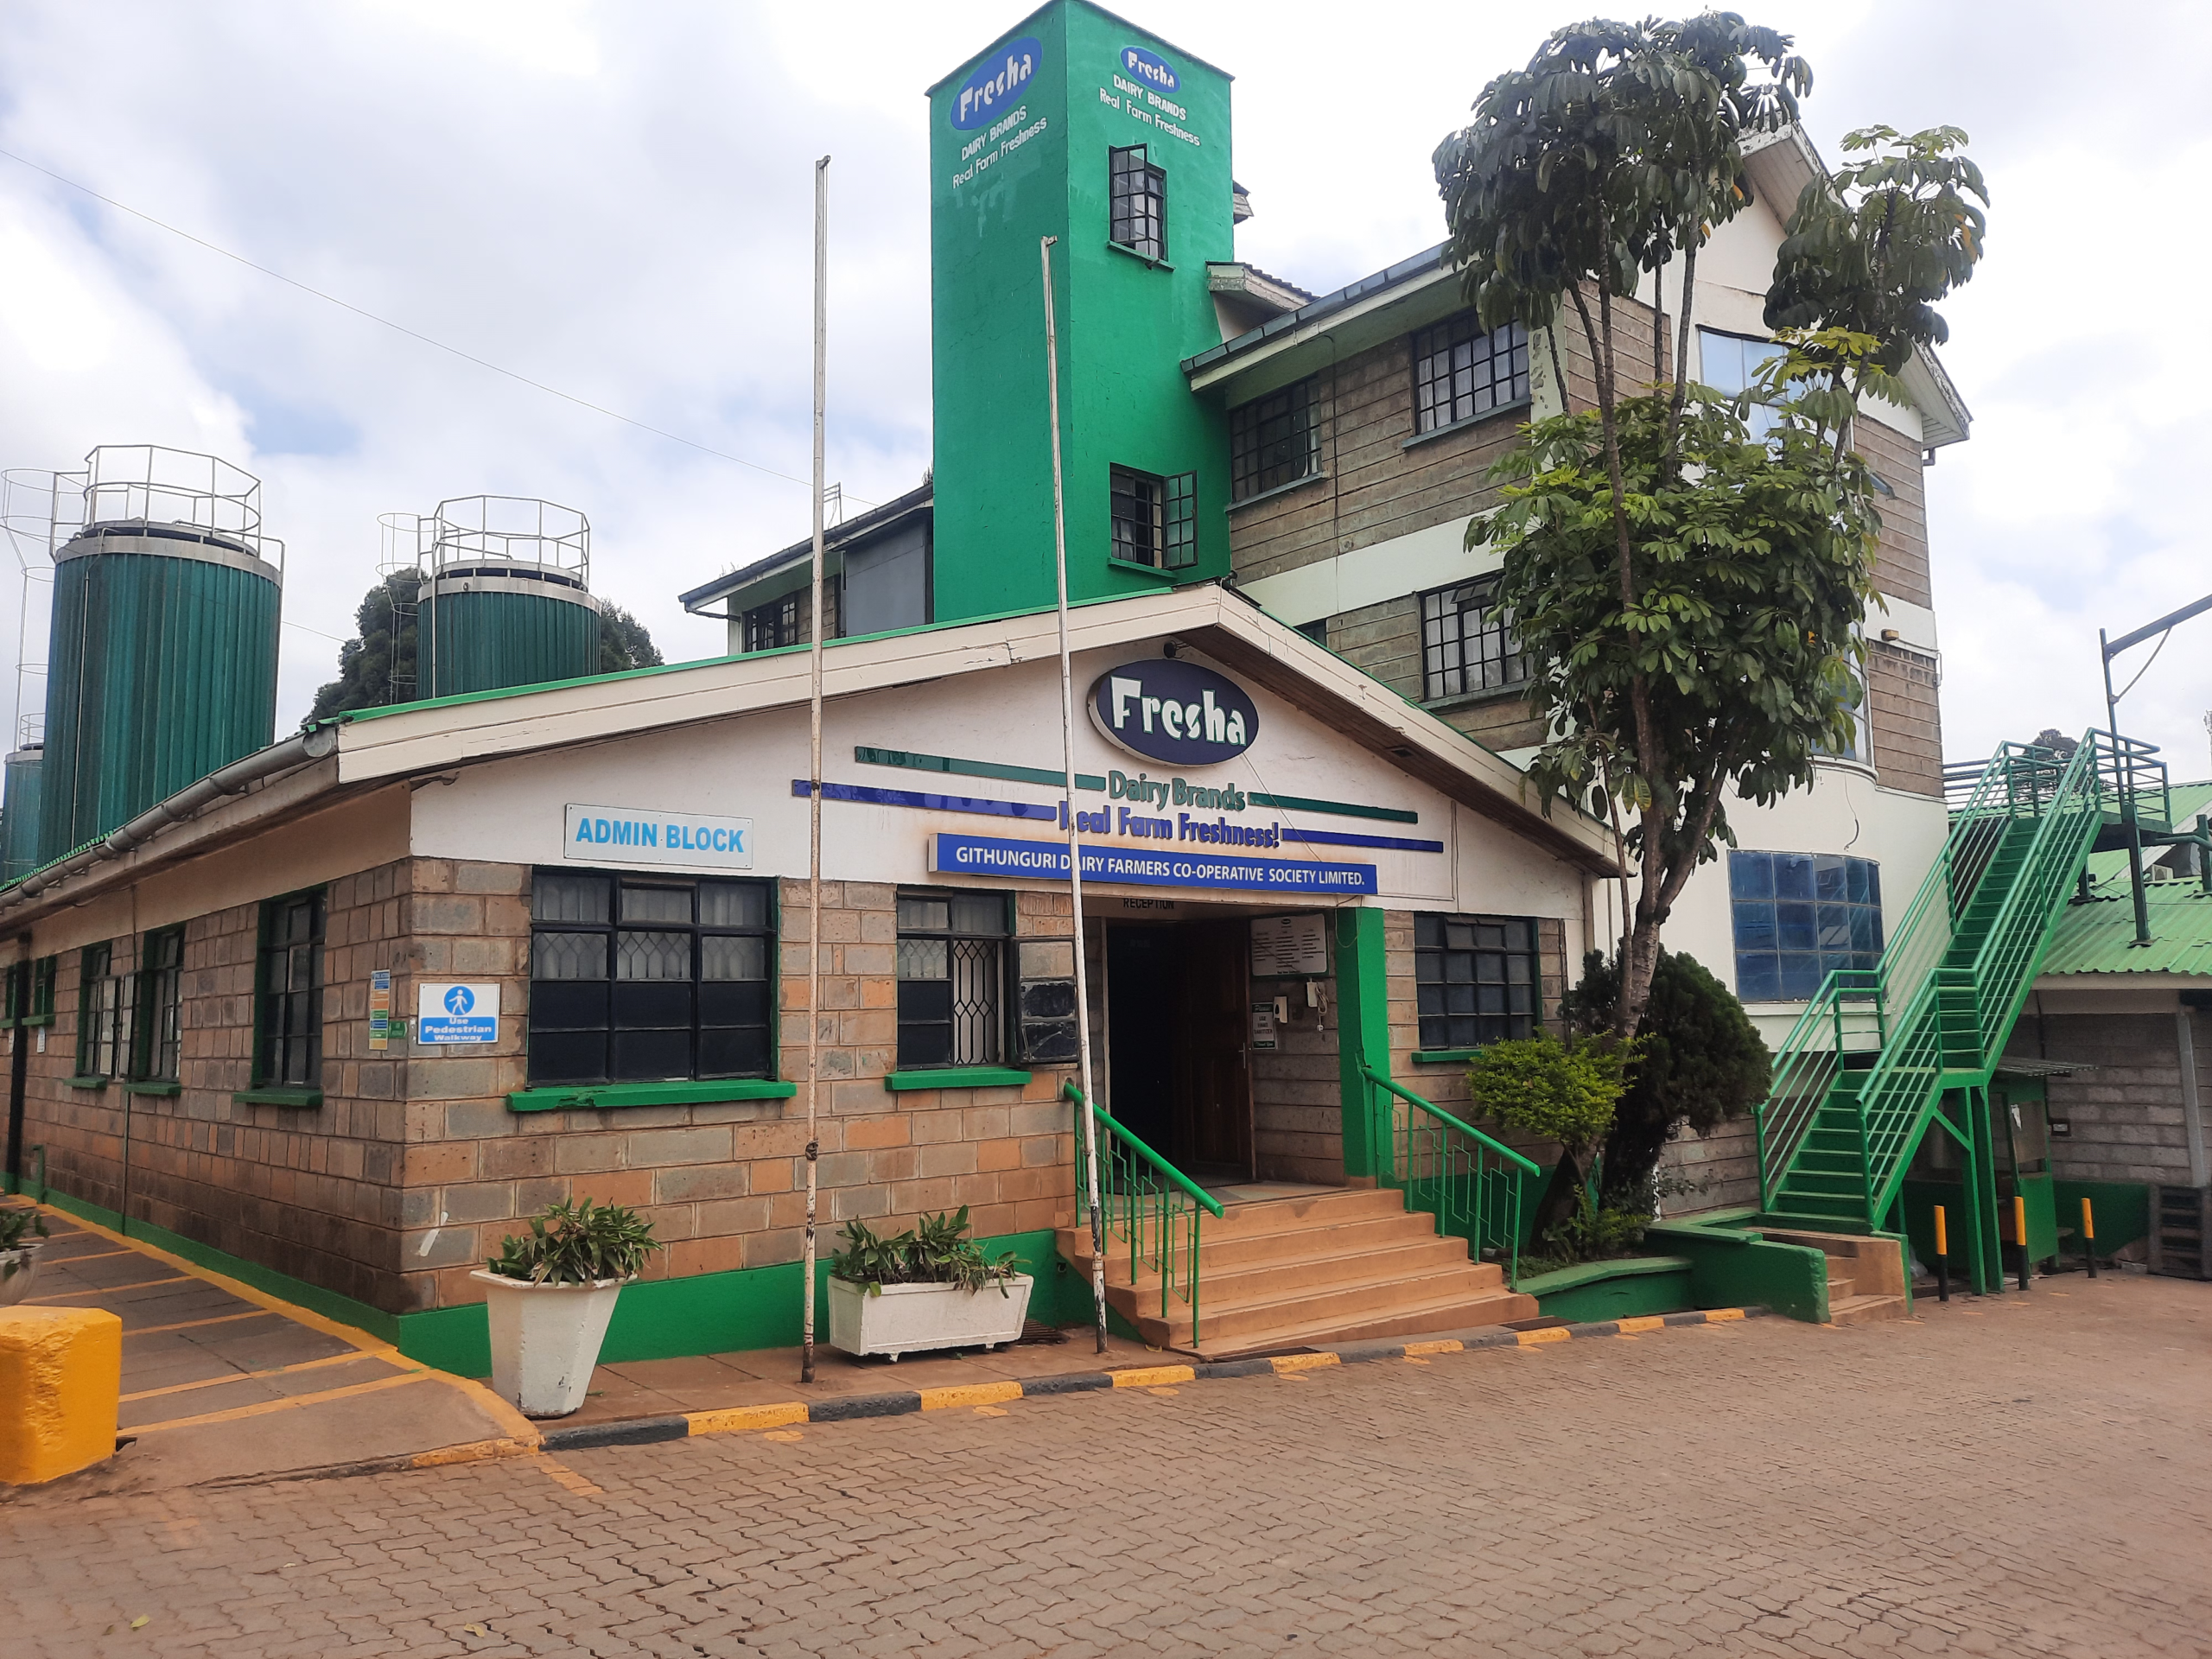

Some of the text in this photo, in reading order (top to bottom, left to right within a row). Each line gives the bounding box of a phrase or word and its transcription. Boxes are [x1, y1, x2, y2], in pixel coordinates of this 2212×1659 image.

[960, 54, 1032, 123] Fresha
[1128, 50, 1175, 88] Fresha
[1099, 86, 1201, 146] Real Farm Freshness
[1113, 73, 1186, 121] DAIRY BRANDS
[952, 117, 1047, 189] Real Farm Freshness
[961, 105, 1027, 162] DAIRY BRANDS
[1109, 675, 1247, 747] Fresha
[1108, 770, 1246, 811] Dairy Brands
[575, 817, 745, 853] ADMIN BLOCK
[1118, 806, 1173, 841] Farm
[1178, 812, 1281, 849] Freshness!
[956, 846, 1365, 886] GITHUNGURI DIRY FARMERS CO-OPERATIVE SOCIETY LIMITED.
[1123, 898, 1175, 910] RECEPTION
[424, 1025, 493, 1034] Pedestrian
